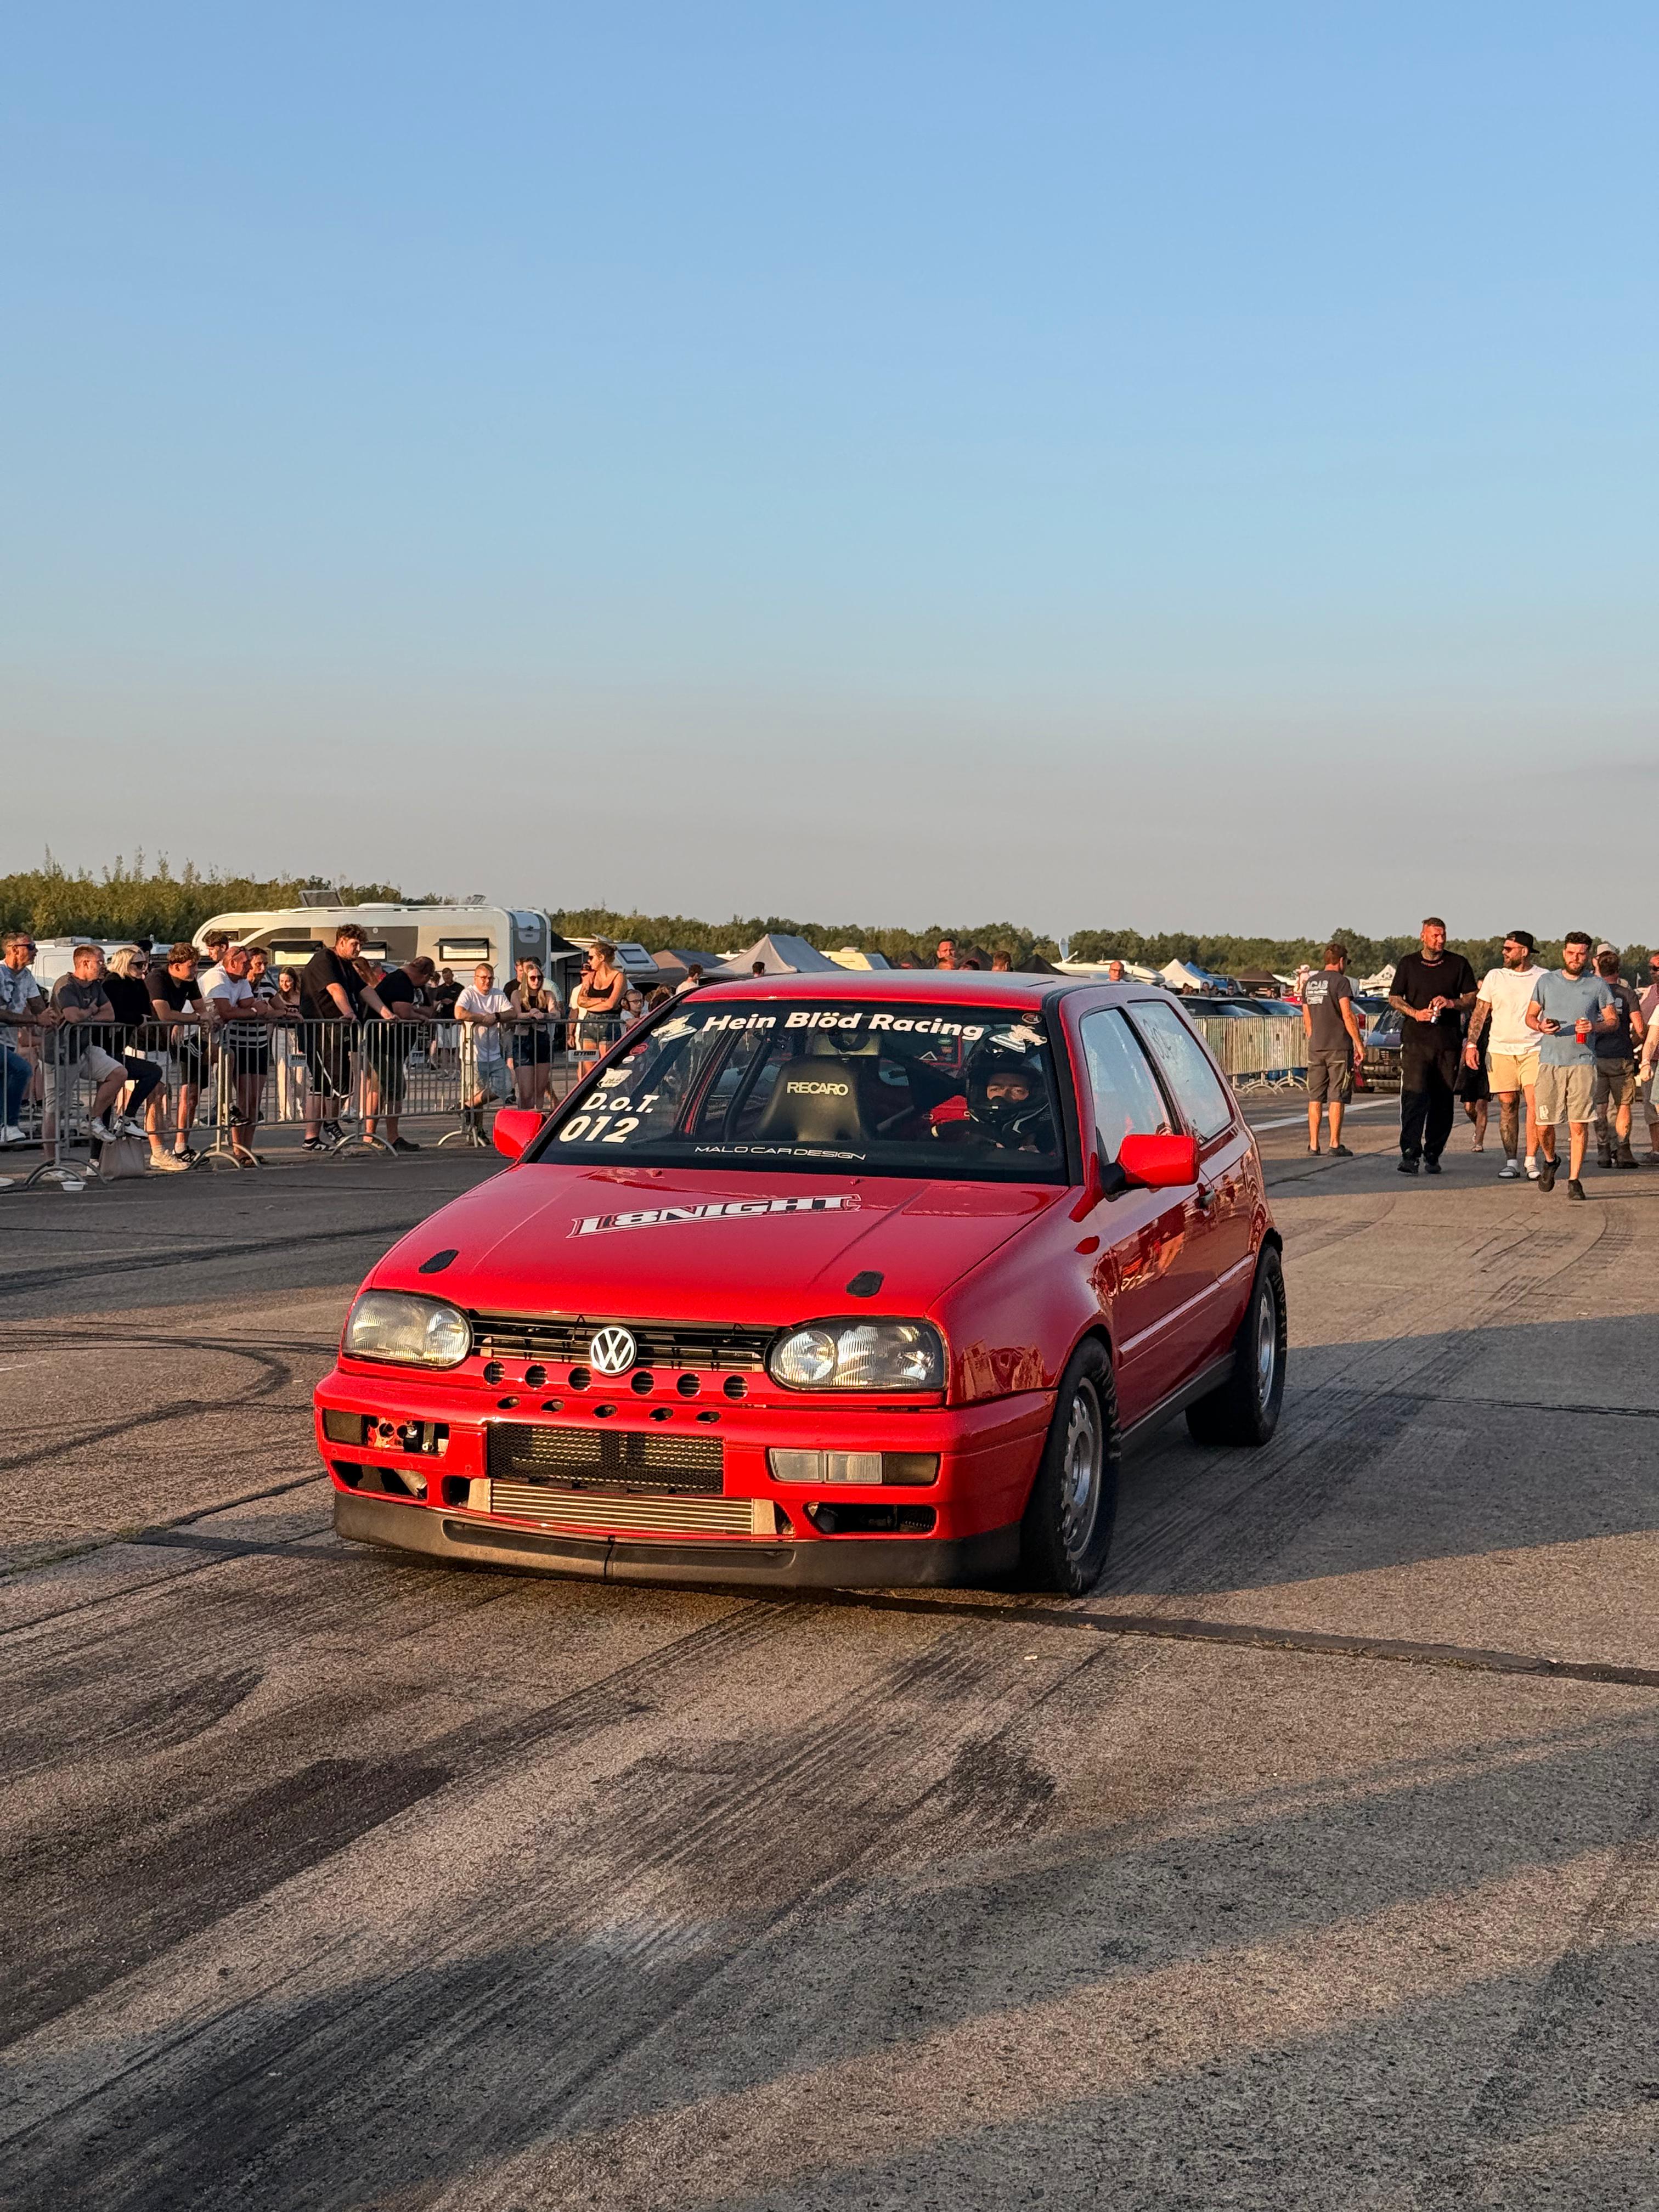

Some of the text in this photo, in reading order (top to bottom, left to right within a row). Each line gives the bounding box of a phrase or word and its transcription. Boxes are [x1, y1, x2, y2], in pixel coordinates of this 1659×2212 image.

[702, 1012, 985, 1041] Hein Blöd Racing
[786, 1082, 849, 1096] RECARO
[580, 1092, 660, 1114] D.o.T.
[558, 1115, 640, 1143] 012
[751, 1147, 792, 1155] CAR
[793, 1149, 866, 1161] DESIGN
[591, 1327, 636, 1375] VW
